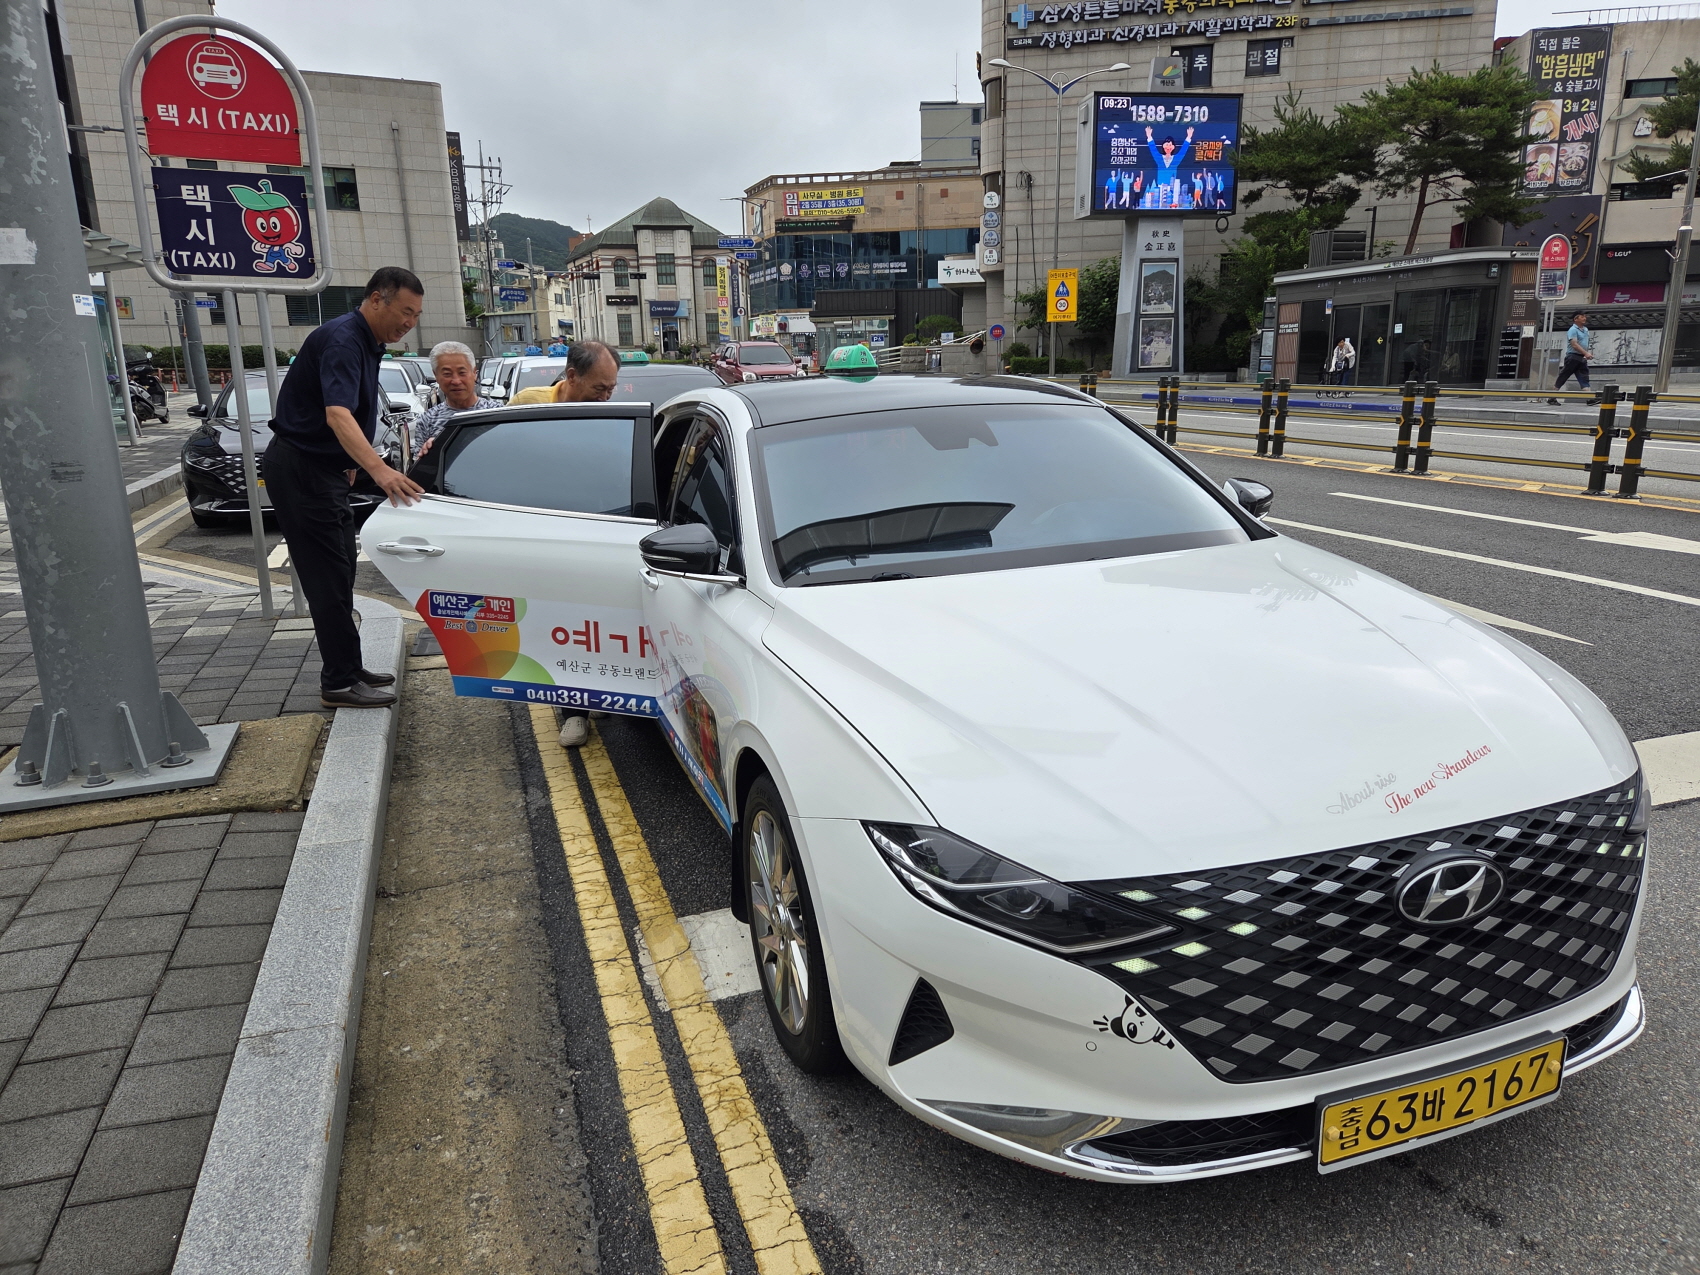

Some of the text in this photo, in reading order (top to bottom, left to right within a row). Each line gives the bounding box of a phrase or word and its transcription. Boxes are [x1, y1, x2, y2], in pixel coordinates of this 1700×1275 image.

[1040, 29, 1106, 49] 정형외과
[1112, 22, 1178, 42] 신경외과
[1186, 14, 1274, 38] 재활의학과
[1539, 36, 1580, 51] 직접 뽑은
[1554, 81, 1563, 92] &
[1104, 98, 1128, 109] 09:23
[1563, 98, 1597, 113] 3월 2일
[217, 107, 290, 135] (TAXI)
[1131, 104, 1209, 123] 1588-7310
[1562, 112, 1600, 141] 개시!
[829, 190, 844, 198] 병원
[846, 189, 860, 197] 용도
[785, 193, 799, 216] 임대
[1151, 230, 1171, 238] 秋史
[1144, 242, 1177, 251] 金正喜
[171, 249, 236, 270] (TAXI)
[433, 594, 511, 613] 예산군 개인
[444, 620, 509, 633] Best Driver
[556, 660, 657, 681] 예산군 공동브랜드
[1384, 791, 1414, 815] The
[1413, 777, 1437, 799] new
[1453, 1051, 1550, 1120] 2167
